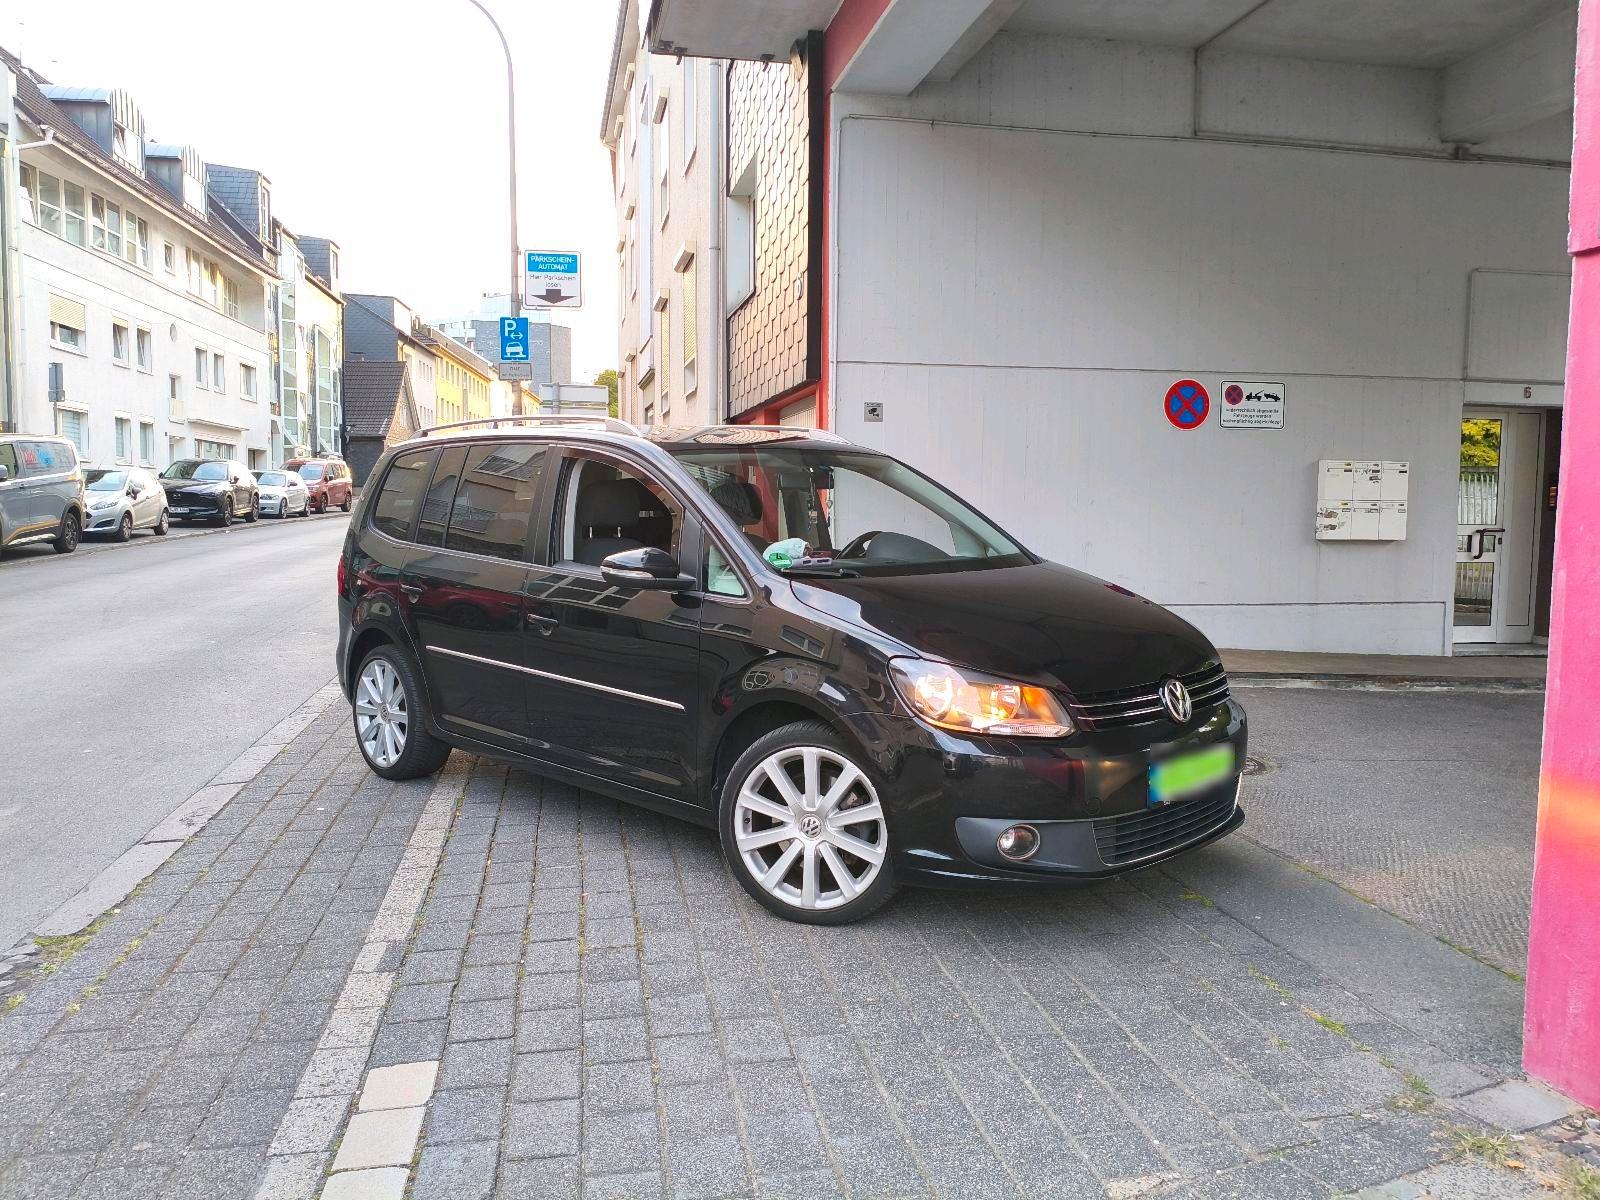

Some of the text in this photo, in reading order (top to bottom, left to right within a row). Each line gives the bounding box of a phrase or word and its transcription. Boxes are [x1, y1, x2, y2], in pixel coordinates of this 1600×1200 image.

[530, 255, 575, 264] PARKSCHEIN-
[537, 263, 569, 271] AUTOMAT
[504, 319, 517, 337] P
[1524, 386, 1532, 399] 6
